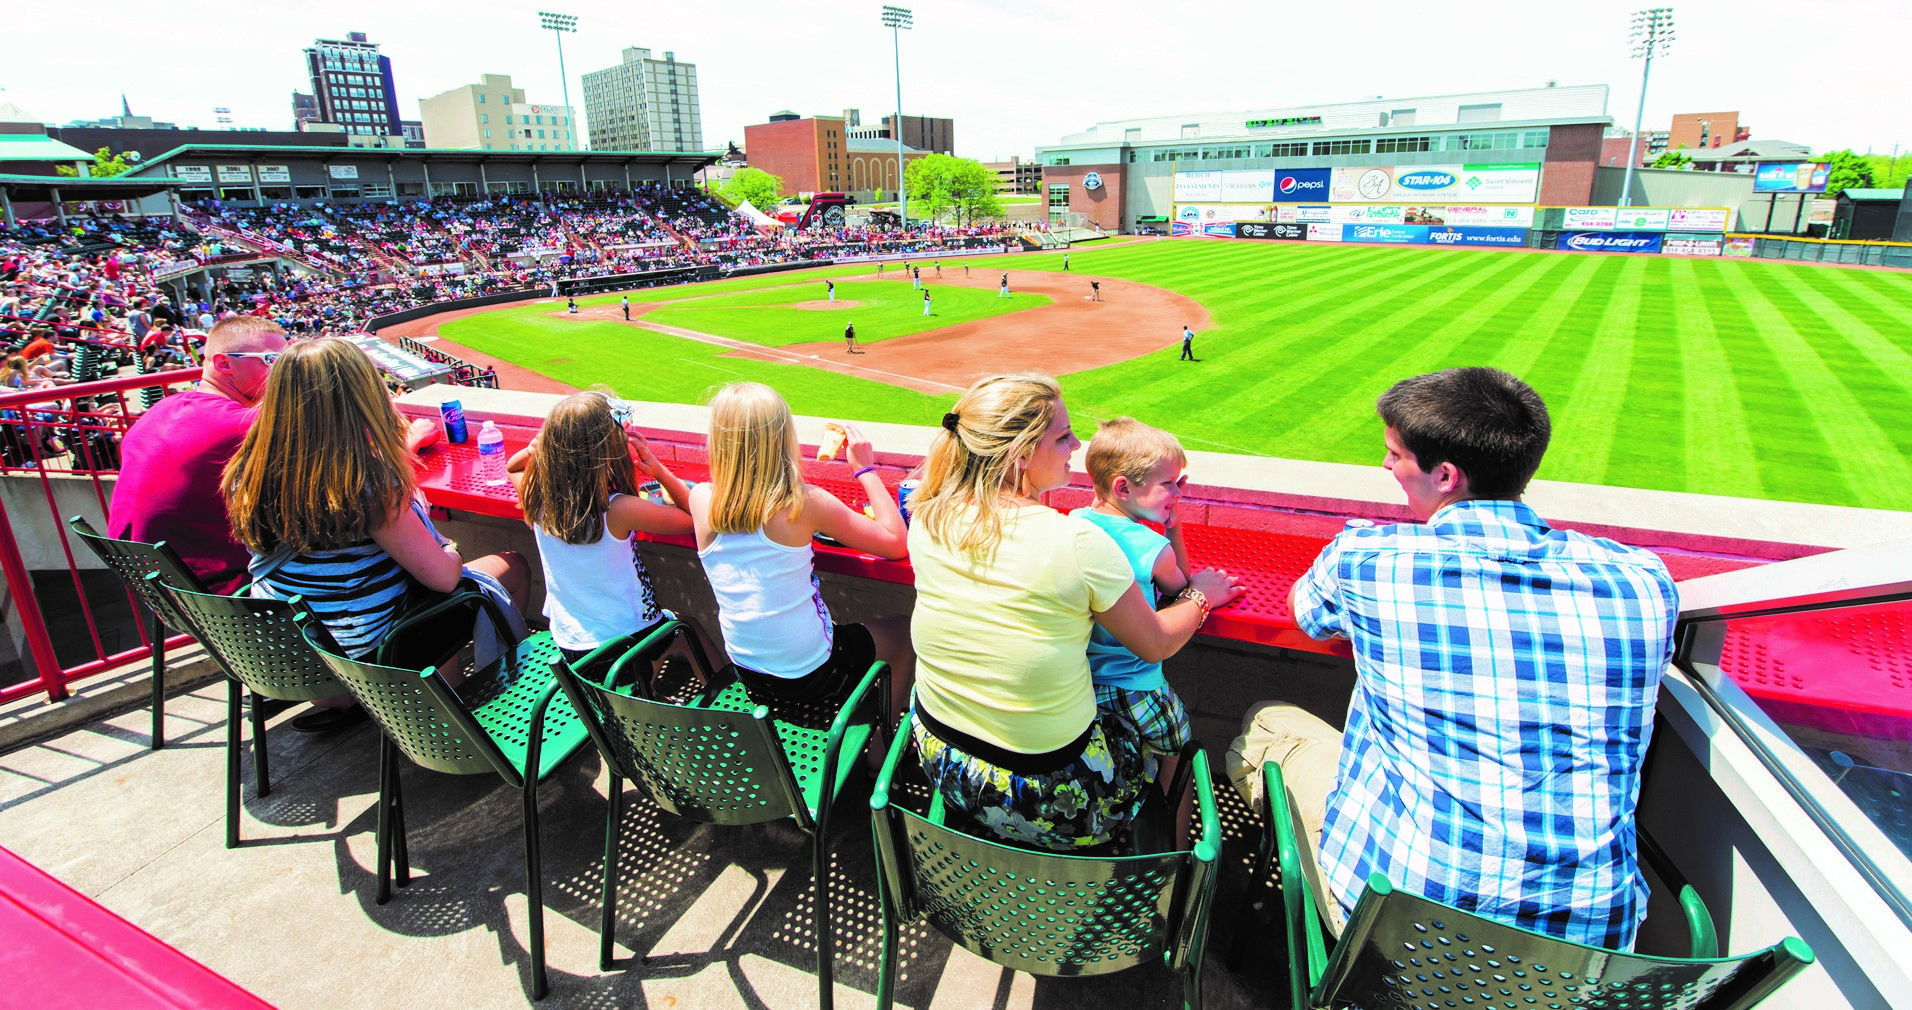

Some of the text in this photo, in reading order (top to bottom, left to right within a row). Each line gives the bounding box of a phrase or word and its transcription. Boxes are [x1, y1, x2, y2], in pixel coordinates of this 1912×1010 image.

[1297, 180, 1324, 189] pepsi
[1367, 226, 1391, 237] Erie
[1429, 232, 1463, 241] FORTIS
[1466, 235, 1521, 243] www.fortis.edu
[1574, 237, 1650, 247] BUD LIGHT
